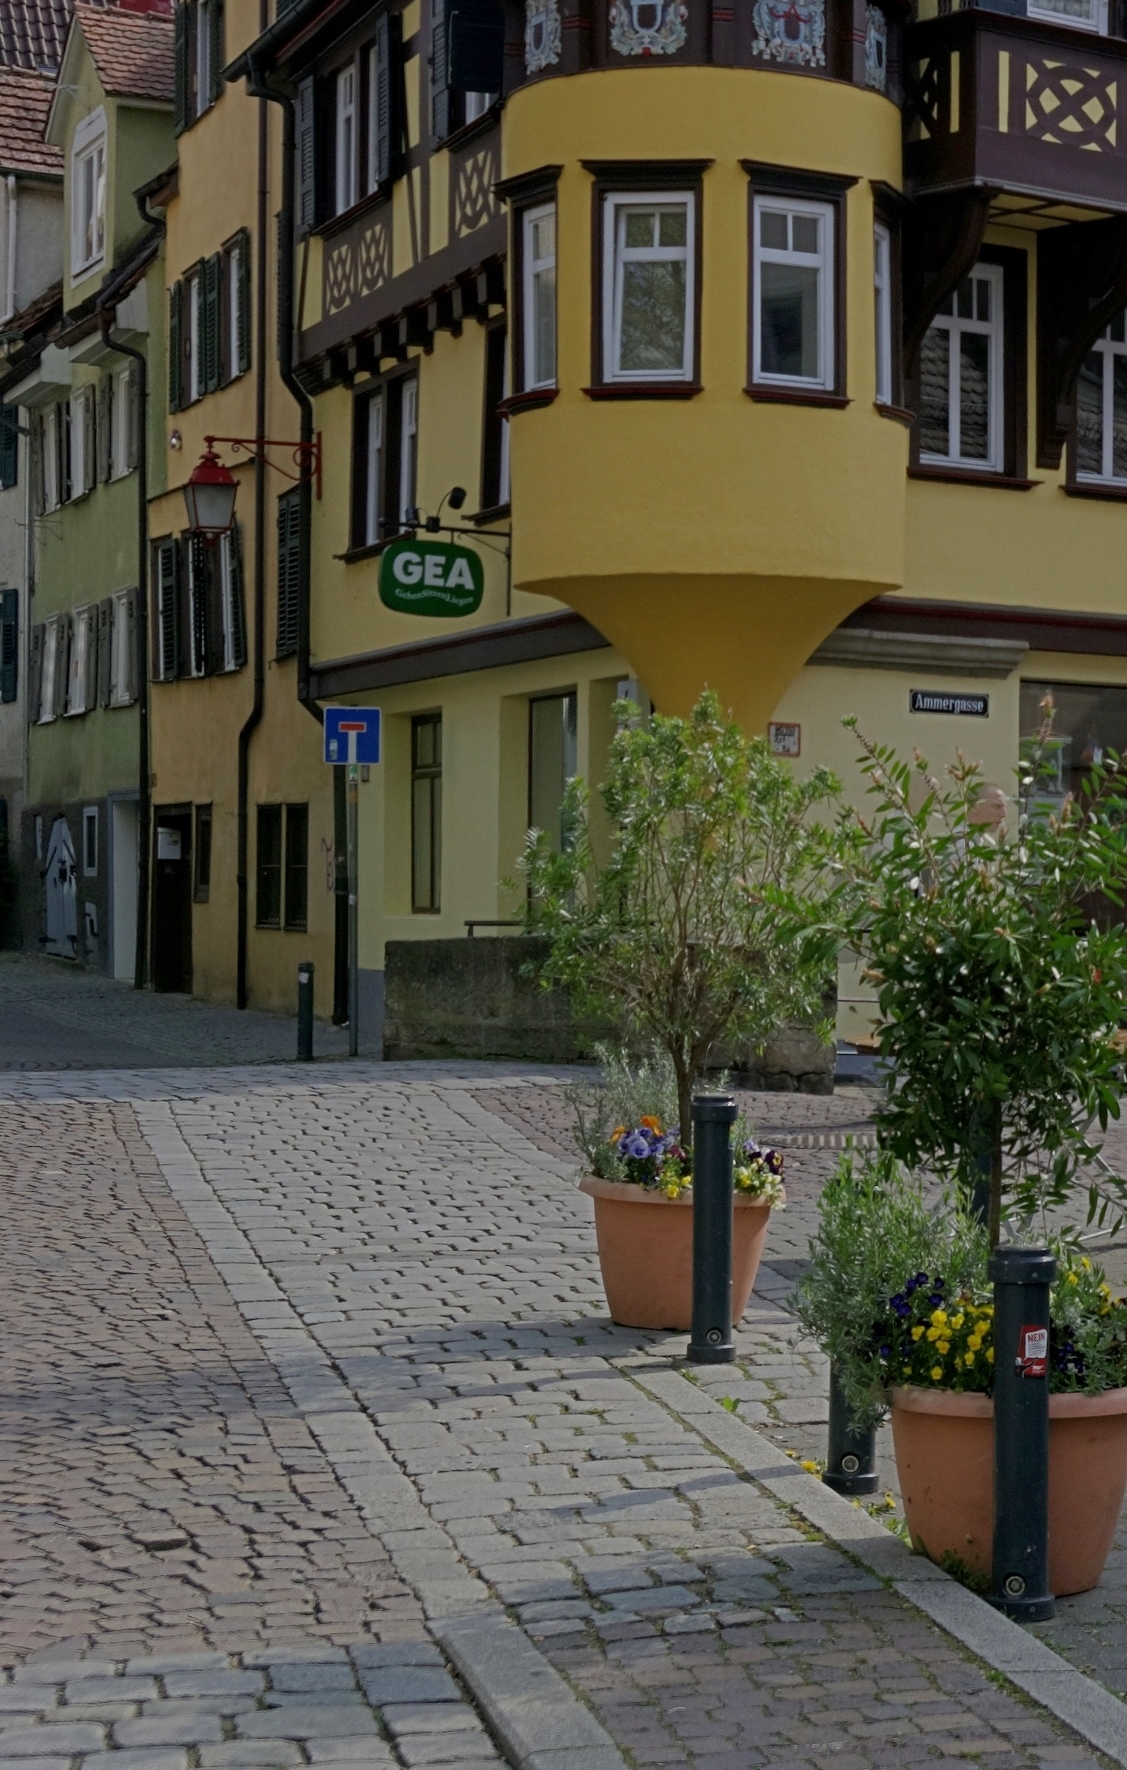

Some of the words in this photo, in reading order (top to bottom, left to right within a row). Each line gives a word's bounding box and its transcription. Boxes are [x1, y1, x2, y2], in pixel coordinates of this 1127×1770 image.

[393, 551, 475, 590] GEA
[915, 692, 984, 714] Ammergasse
[1027, 1332, 1045, 1342] NEIN
